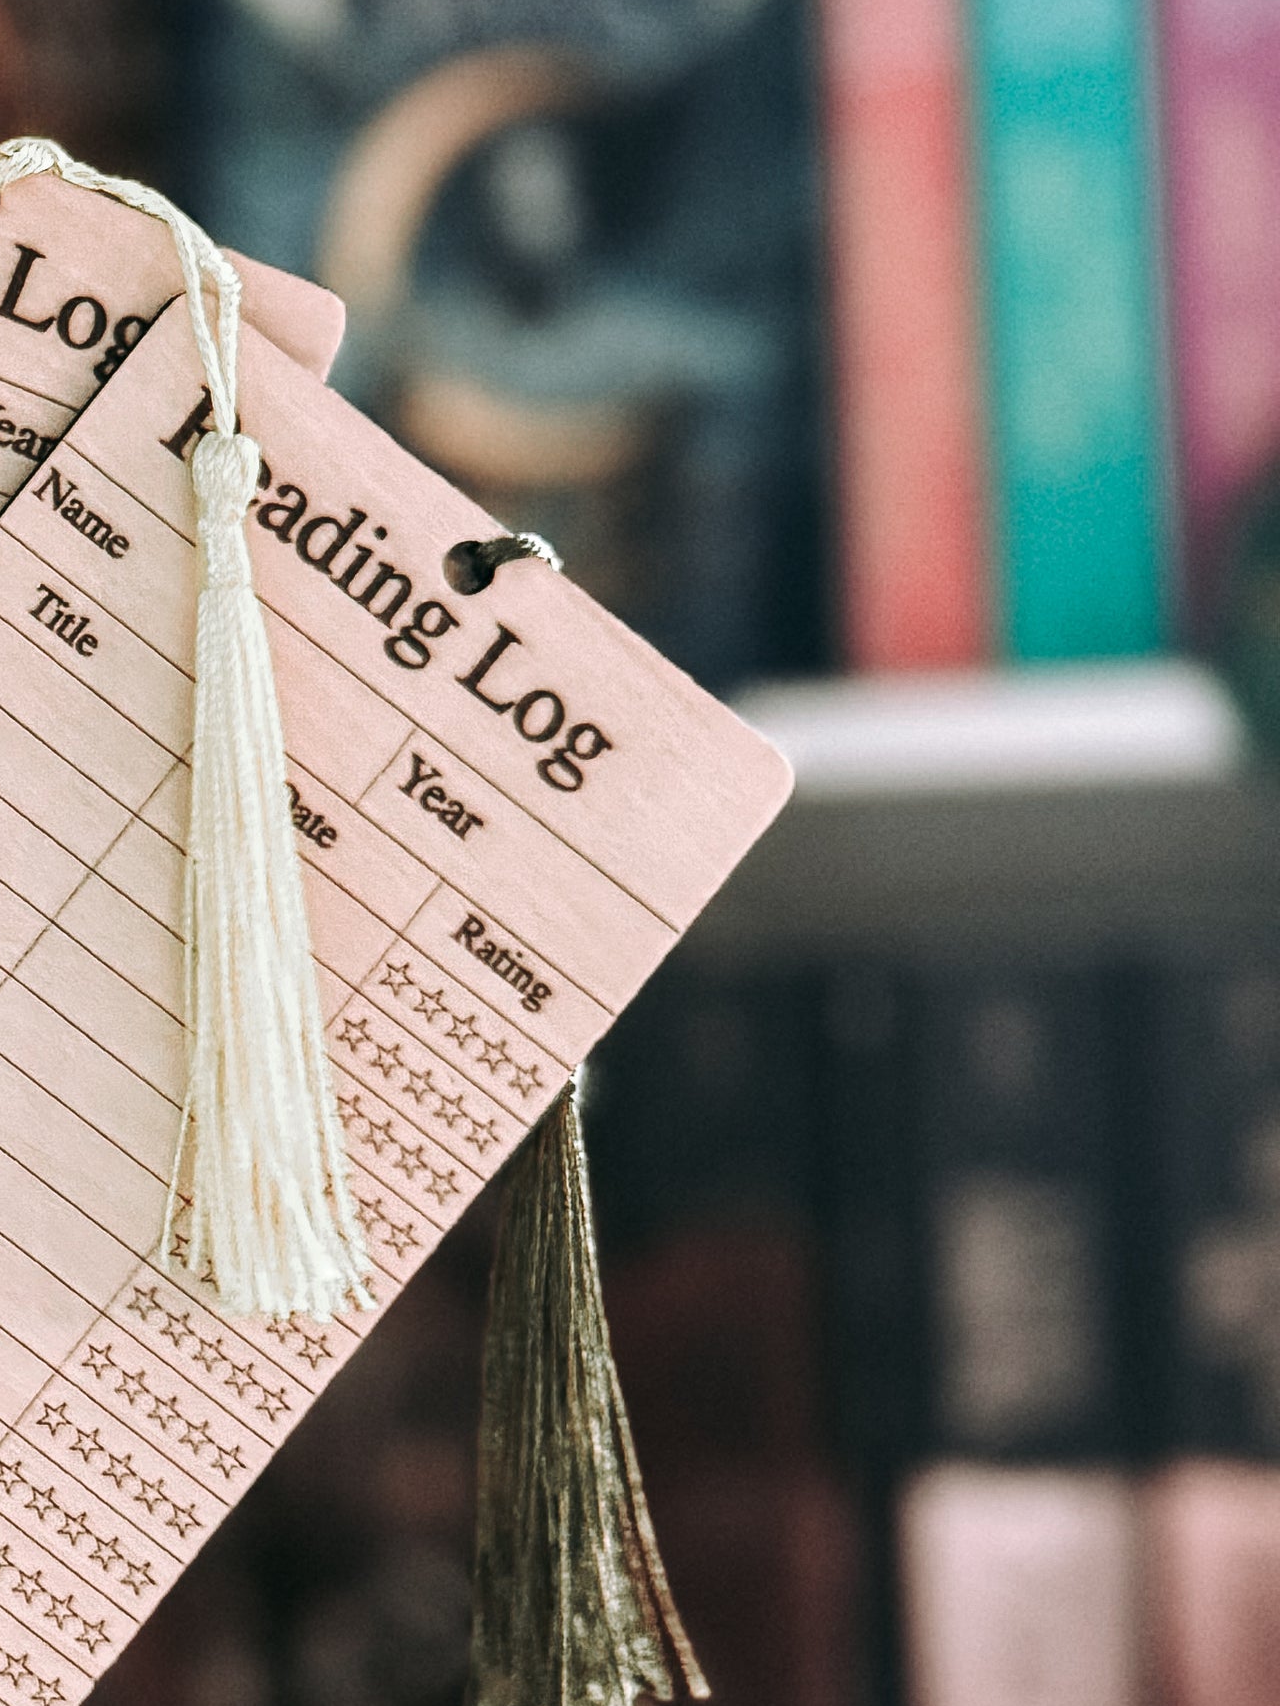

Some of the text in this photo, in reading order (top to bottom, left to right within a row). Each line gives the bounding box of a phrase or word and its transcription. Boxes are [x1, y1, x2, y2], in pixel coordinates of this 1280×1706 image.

[32, 467, 130, 561] Name
[28, 583, 100, 659] Title
[455, 622, 612, 794] Log
[398, 753, 484, 843] Year
[449, 913, 553, 1015] Rating
